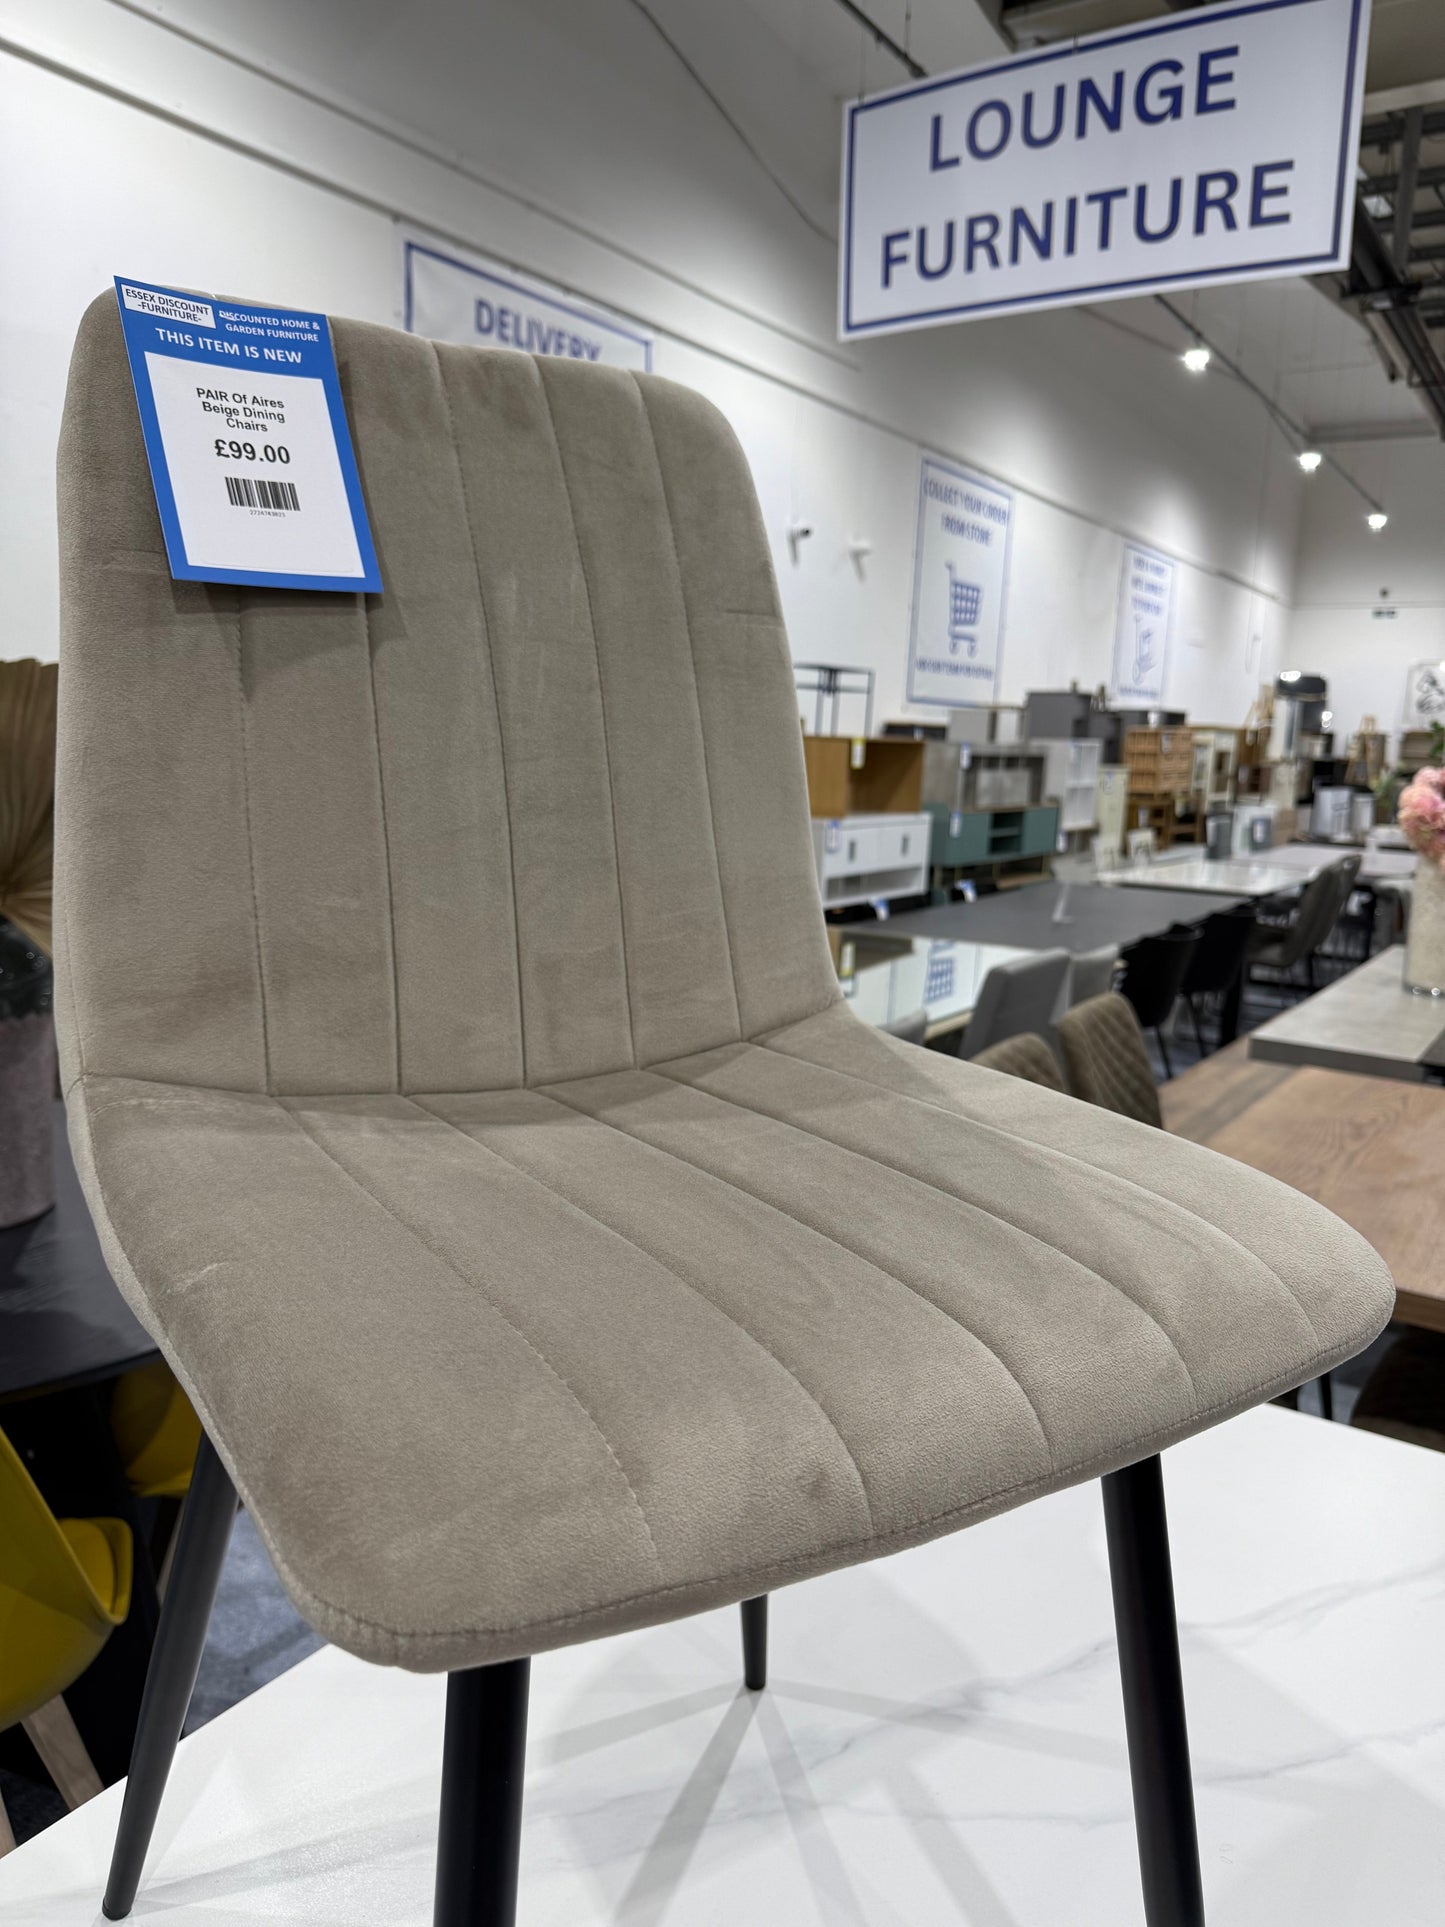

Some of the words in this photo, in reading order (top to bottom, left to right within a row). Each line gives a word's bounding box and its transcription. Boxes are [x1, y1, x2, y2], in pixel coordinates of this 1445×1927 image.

[928, 45, 1241, 173] LOUNGE
[880, 159, 1295, 290] FURNITURE
[125, 288, 157, 304] ESSEX
[158, 296, 209, 316] DISCOUNT
[218, 309, 280, 327] DISCOUNTED
[281, 317, 311, 330] HOME
[312, 321, 321, 331] &
[225, 323, 265, 337] GARDEN
[266, 329, 320, 342] FURNITURE
[475, 298, 601, 362] DELIVERY
[155, 327, 194, 347] THIS
[198, 337, 240, 356] ITEM
[244, 345, 260, 359] IS
[263, 347, 302, 364] NEW
[196, 387, 229, 402] PAIR
[232, 393, 248, 405] Of
[251, 395, 285, 409] Aires
[202, 401, 240, 418] Beige
[243, 407, 286, 424] Dining
[226, 417, 268, 432] Chairs
[214, 438, 291, 465] £99.00
